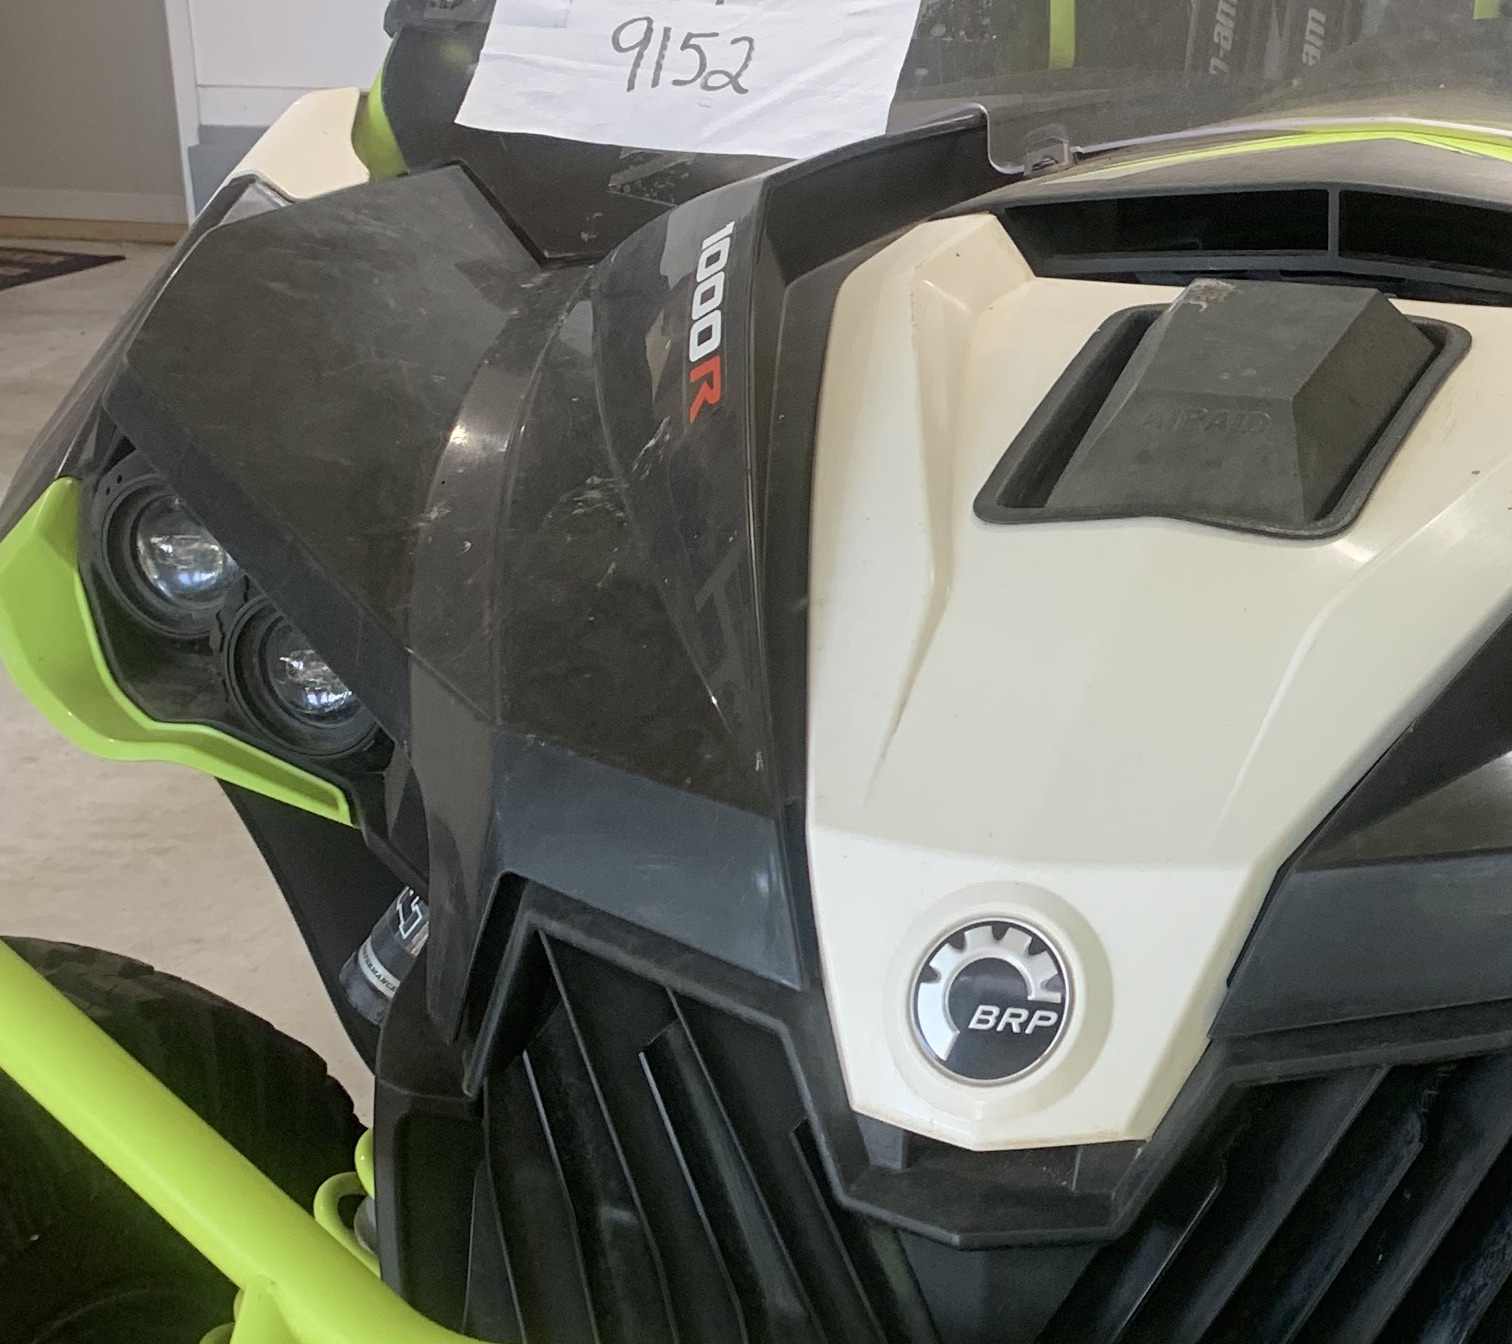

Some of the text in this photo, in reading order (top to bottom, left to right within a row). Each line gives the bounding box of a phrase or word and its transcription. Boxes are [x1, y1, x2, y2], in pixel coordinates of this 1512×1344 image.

[611, 16, 756, 94] 9152
[689, 221, 735, 424] 1000R
[968, 1005, 1059, 1035] BRP
